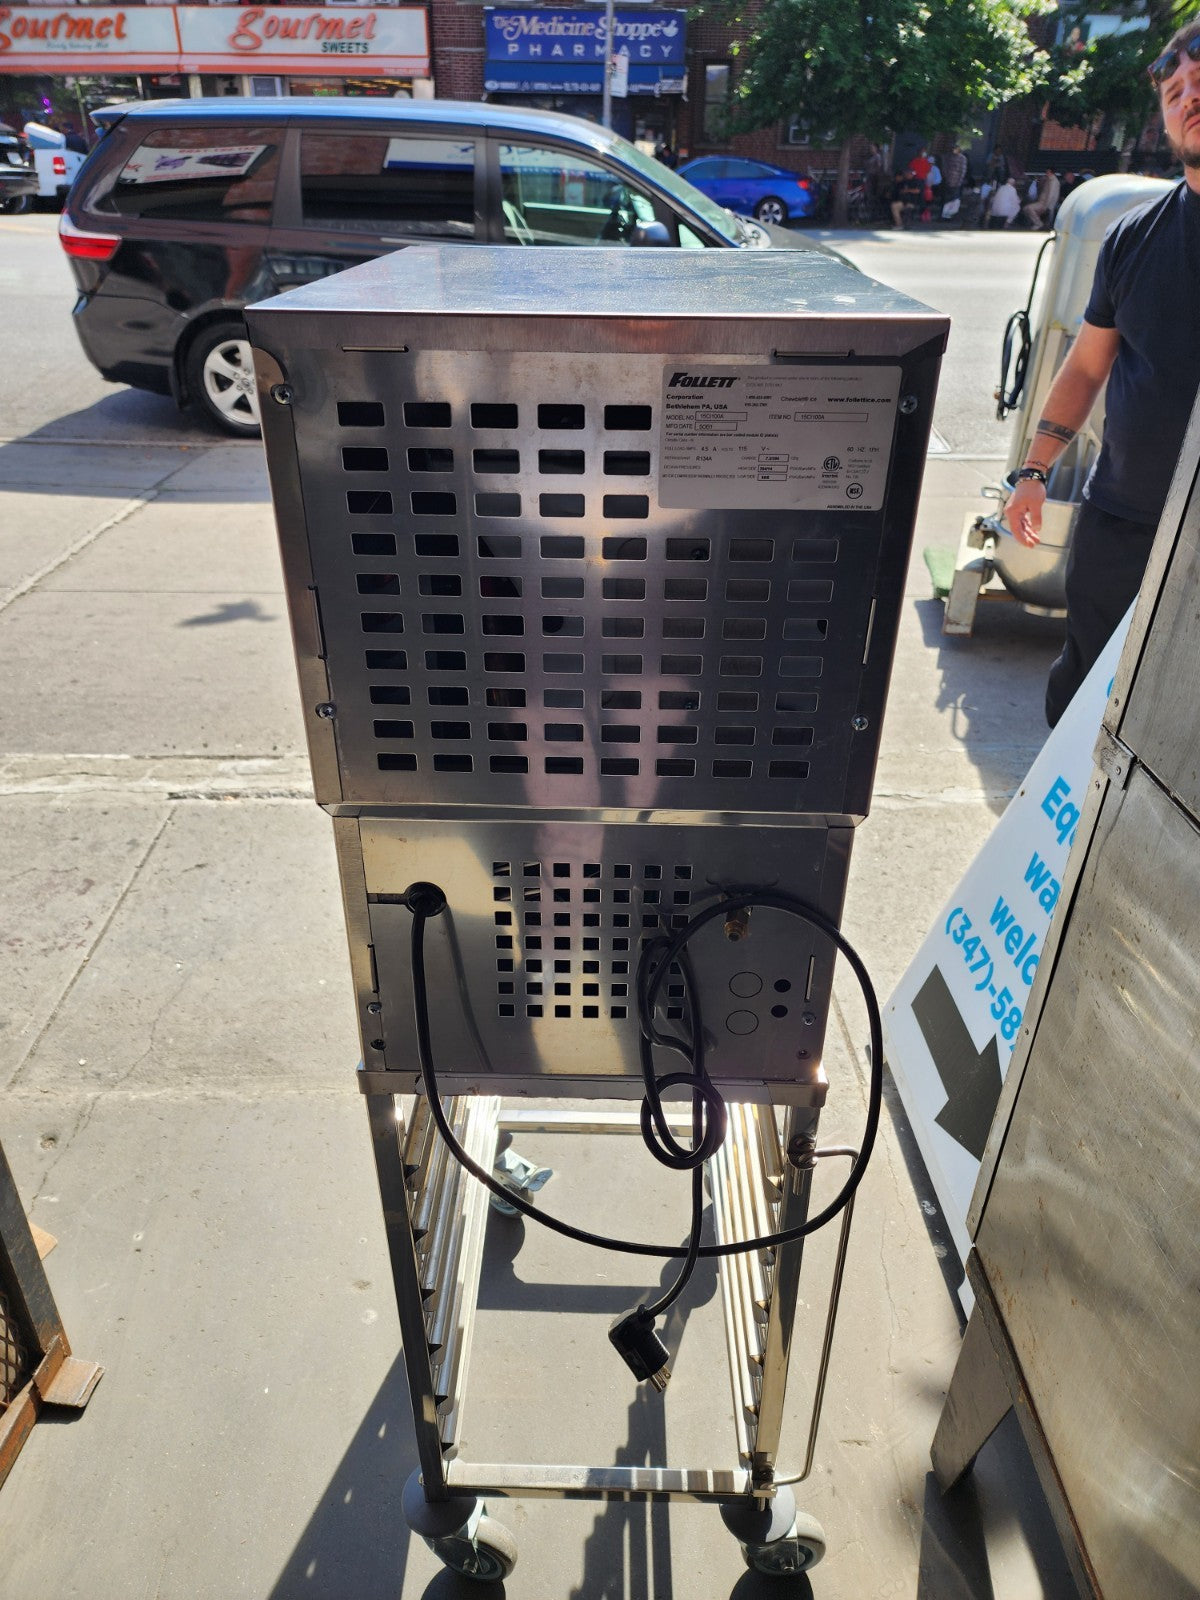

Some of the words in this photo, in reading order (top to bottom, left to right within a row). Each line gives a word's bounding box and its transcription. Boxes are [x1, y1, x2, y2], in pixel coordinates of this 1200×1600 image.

[503, 16, 595, 40] Medicine
[321, 41, 369, 54] SWEETS
[508, 43, 673, 58] PHARMACY
[1040, 776, 1080, 847] Eq
[945, 907, 1022, 1052] (347)-58
